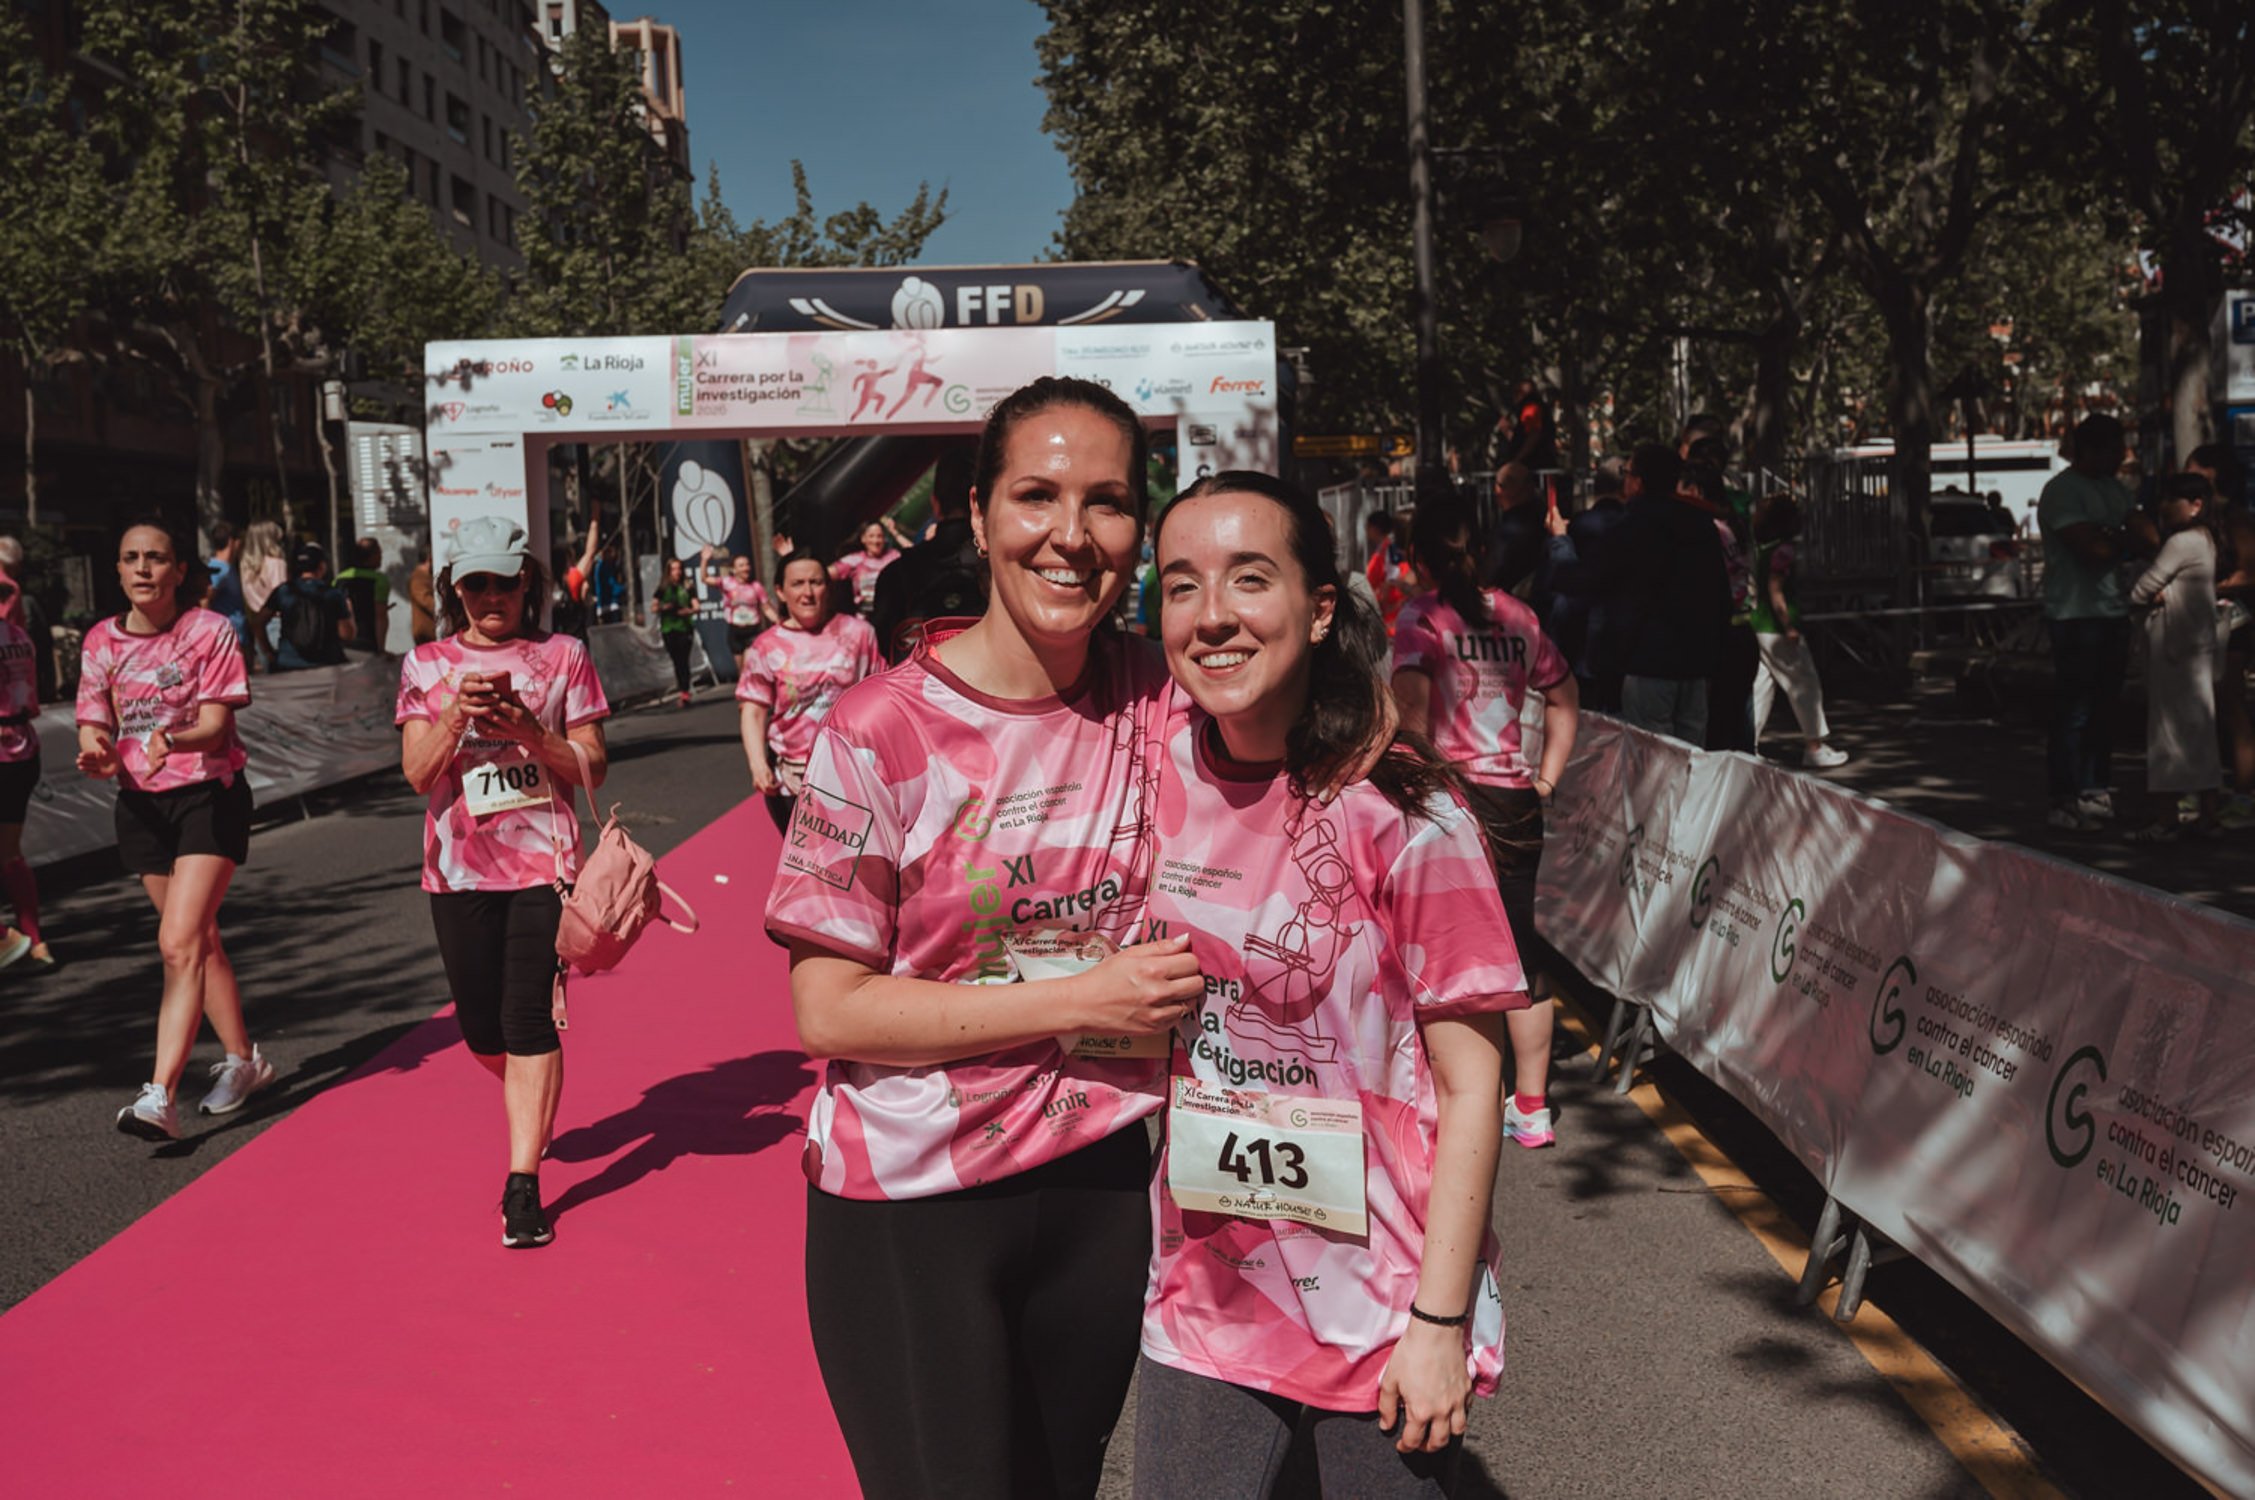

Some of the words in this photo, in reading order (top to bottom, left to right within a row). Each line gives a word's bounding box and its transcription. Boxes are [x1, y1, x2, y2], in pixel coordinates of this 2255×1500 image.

[957, 284, 1044, 326] FFD
[584, 356, 601, 371] La
[605, 355, 644, 373] Rioja
[697, 371, 755, 386] Carrera
[759, 371, 785, 386] por
[789, 370, 804, 383] la
[697, 388, 801, 404] investigación
[477, 763, 541, 796] 7108
[996, 789, 1044, 806] asociación
[996, 806, 1027, 818] contra
[1028, 801, 1039, 811] el
[1000, 821, 1013, 830] en
[1013, 817, 1026, 828] La
[1026, 811, 1049, 825] Rioja
[1002, 854, 1036, 889] XI
[1161, 871, 1184, 882] contra
[1164, 859, 1201, 873] asociación
[1202, 866, 1243, 881] española
[1011, 878, 1121, 925] Carrera
[1158, 882, 1167, 890] en
[1168, 883, 1176, 893] La
[1178, 885, 1198, 899] Rioja
[1146, 917, 1168, 943] XI
[1026, 937, 1058, 946] Carrera
[1926, 984, 1997, 1034] asociación
[1998, 1018, 2053, 1063] española
[1917, 1015, 1957, 1051] contra
[1959, 1034, 1974, 1057] el
[1973, 1044, 2018, 1083] cáncer
[1908, 1046, 1925, 1069] en
[1926, 1052, 1941, 1078] La
[1942, 1061, 1975, 1099] Rioja
[1184, 1086, 1196, 1098] XI
[1196, 1091, 1229, 1104] Carrera
[1183, 1099, 1241, 1115] investigación
[2118, 1084, 2200, 1144] asociación
[1217, 1131, 1309, 1190] 413
[2108, 1121, 2157, 1164] contra
[2159, 1147, 2175, 1176] el
[2176, 1158, 2239, 1211] cáncer
[2097, 1158, 2117, 1184] en
[2116, 1163, 2138, 1199] La
[2139, 1177, 2182, 1227] Rioja
[1276, 1202, 1313, 1217] HOUSE
